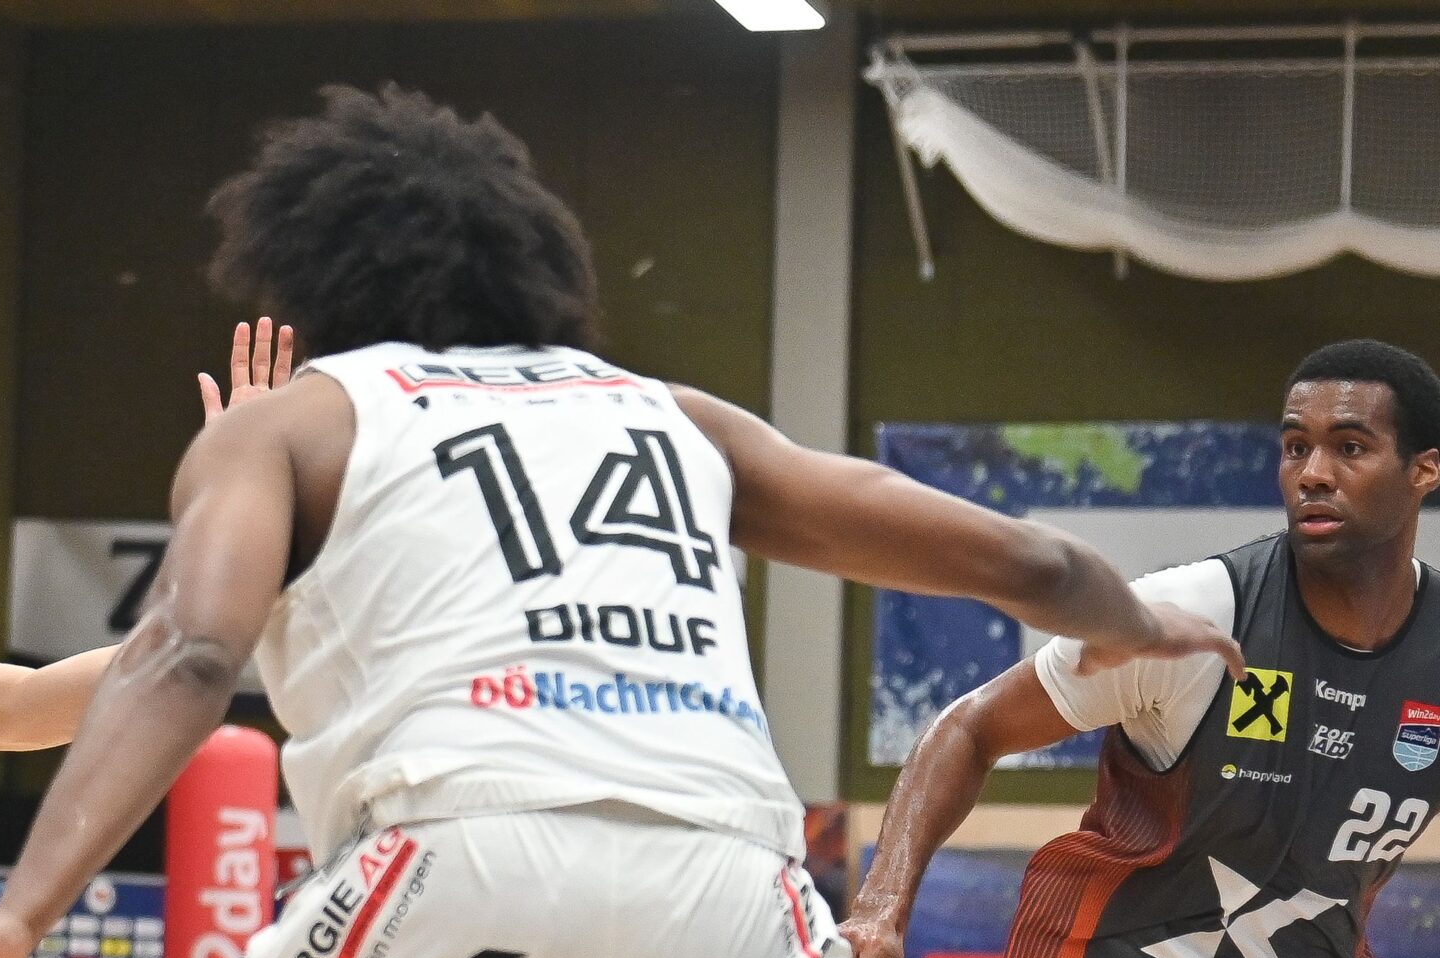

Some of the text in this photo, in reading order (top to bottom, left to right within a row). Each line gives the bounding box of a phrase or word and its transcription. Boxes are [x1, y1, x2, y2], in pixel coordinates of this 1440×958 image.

[434, 422, 720, 592] 14
[524, 602, 718, 656] DIOUF
[1327, 787, 1430, 863] 22
[383, 850, 438, 939] morgen
